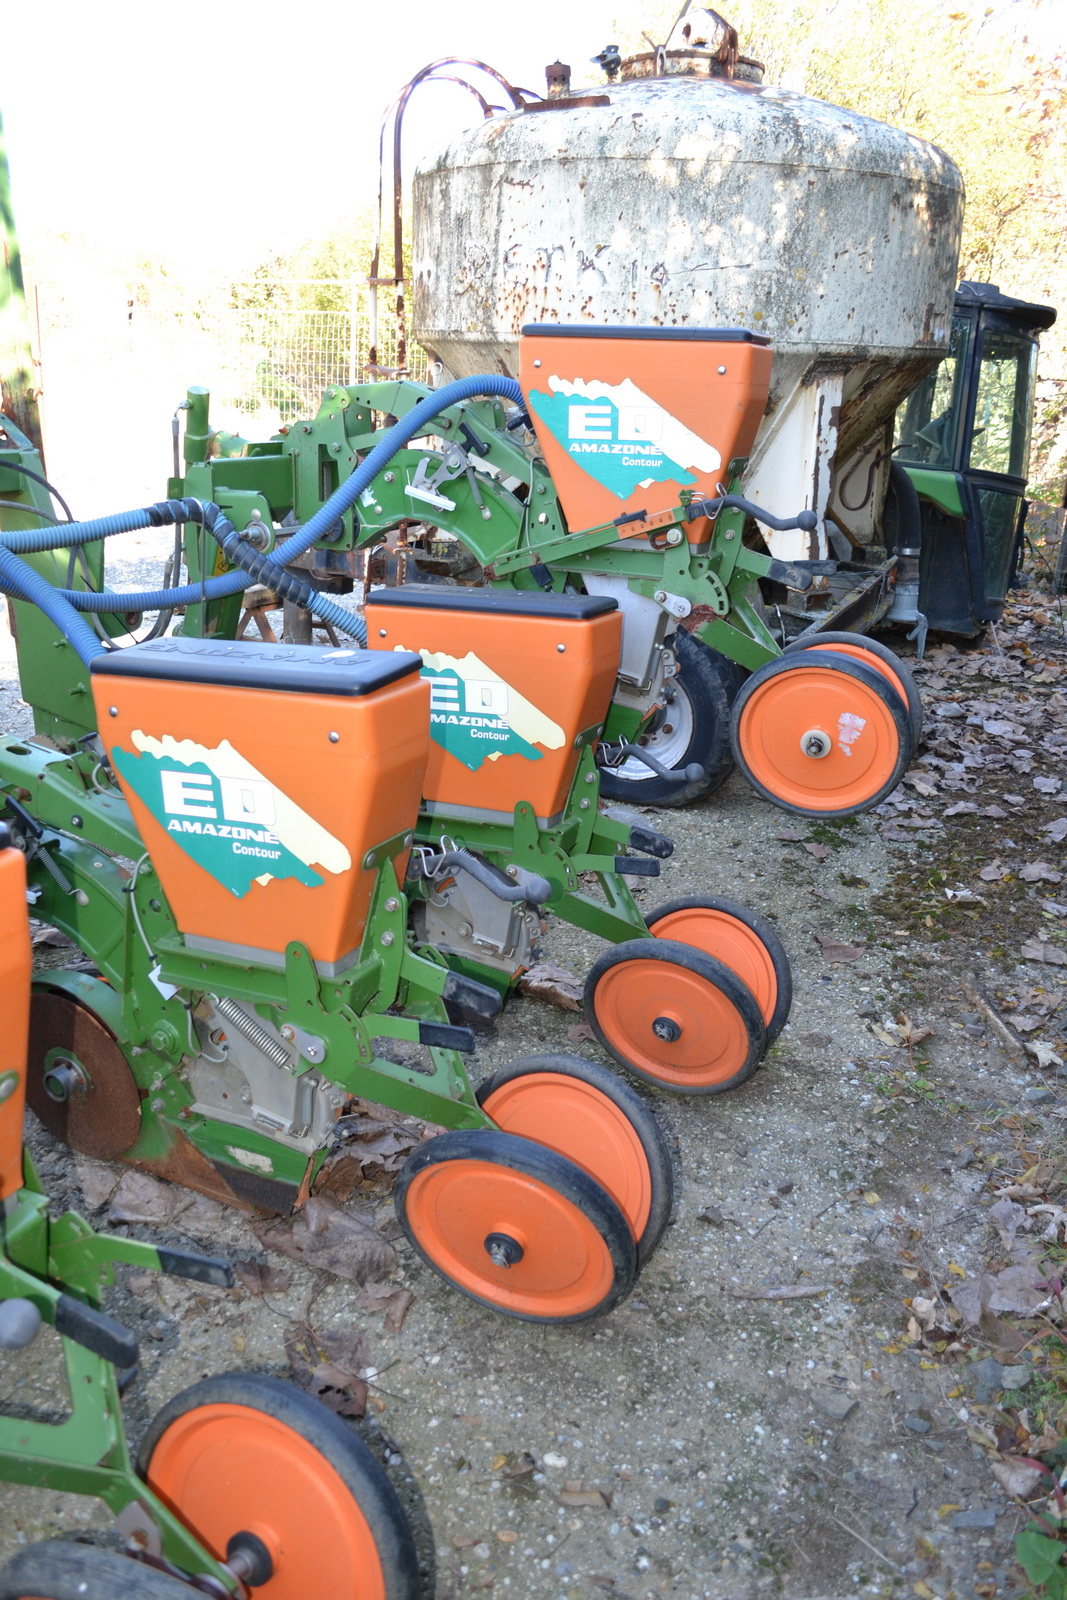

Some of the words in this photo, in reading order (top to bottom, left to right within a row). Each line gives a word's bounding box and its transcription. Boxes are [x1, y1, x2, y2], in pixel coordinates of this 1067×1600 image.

[568, 404, 663, 441] ED
[569, 442, 663, 456] AMAZONE
[622, 456, 663, 467] Contour
[420, 676, 509, 716] ED
[430, 713, 510, 730] MAZONE
[470, 728, 510, 741] Contour
[160, 769, 277, 827] ED
[167, 818, 280, 845] AMAZONE
[232, 842, 281, 860] Contour
